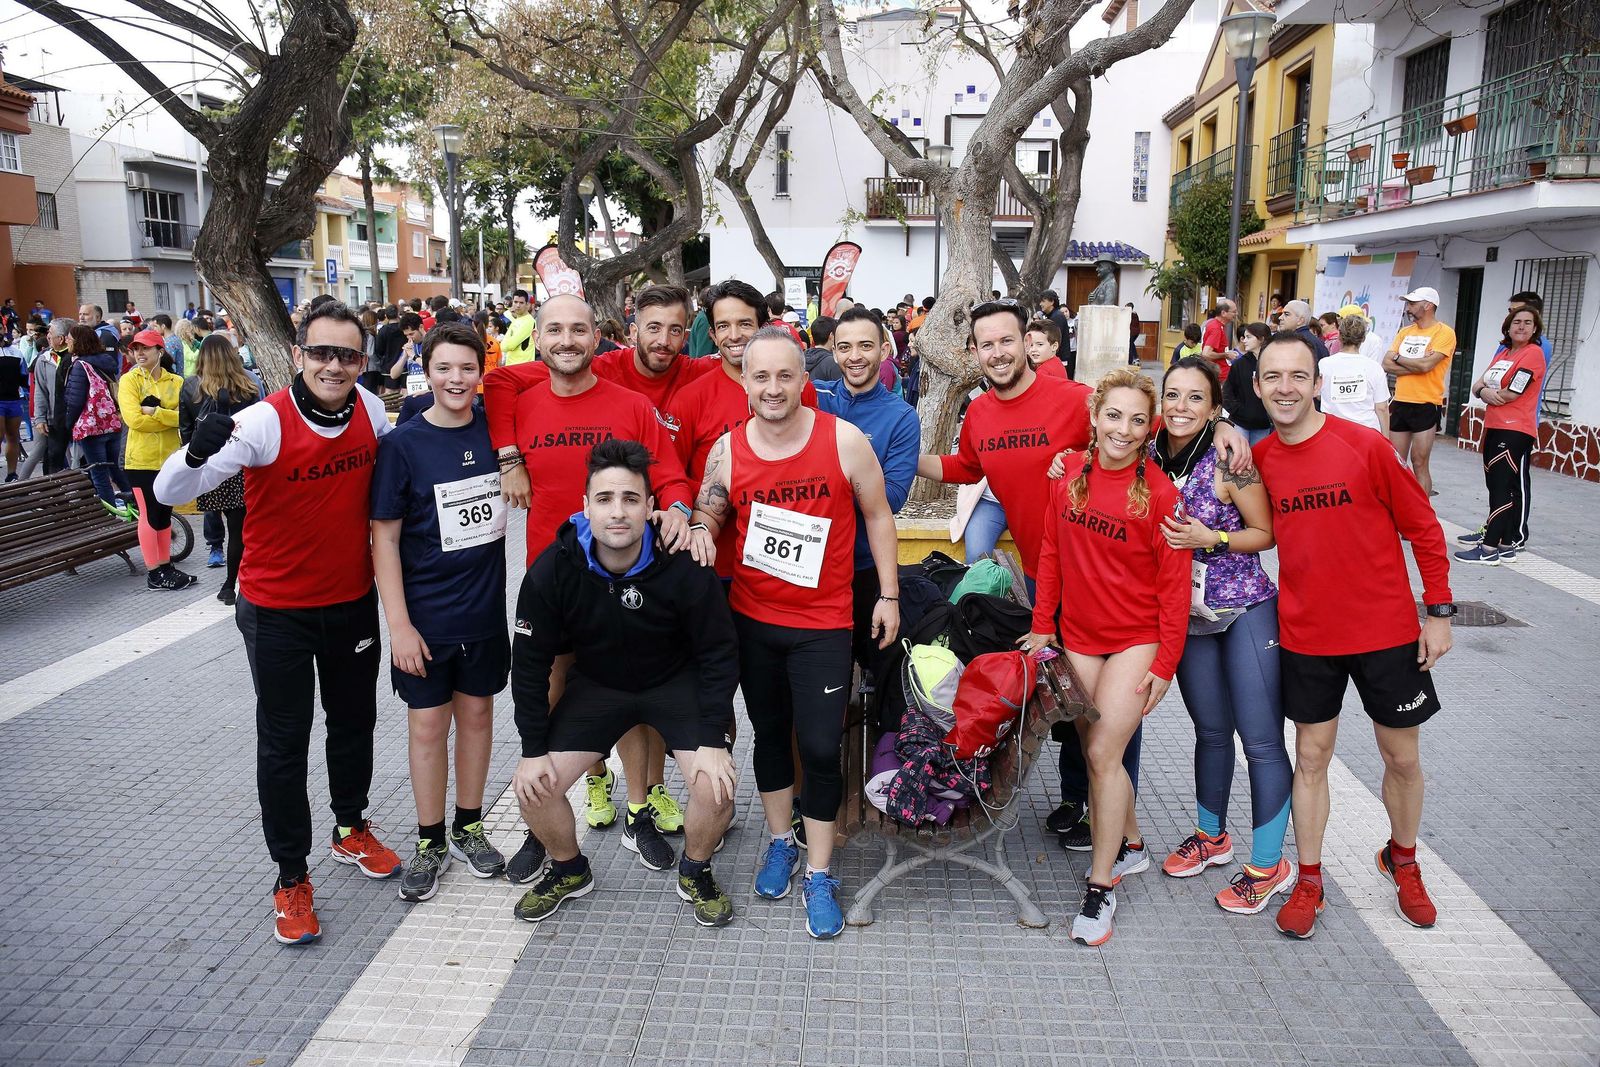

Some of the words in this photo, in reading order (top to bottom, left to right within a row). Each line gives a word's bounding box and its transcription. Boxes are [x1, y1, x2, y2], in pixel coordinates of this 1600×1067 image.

[1339, 384, 1358, 394] 967
[1003, 426, 1046, 435] ENTRENAMIENTOS
[978, 432, 1050, 452] J.SARRIA
[287, 449, 372, 482] J.SARRIA
[775, 476, 826, 486] ENTRENAMIENTOS
[1297, 481, 1346, 493] ENTRENAMIENTOS
[739, 483, 831, 506] J.SARRIA
[458, 503, 493, 527] 369
[1061, 504, 1127, 543] J.SARRIA
[764, 536, 803, 562] 861
